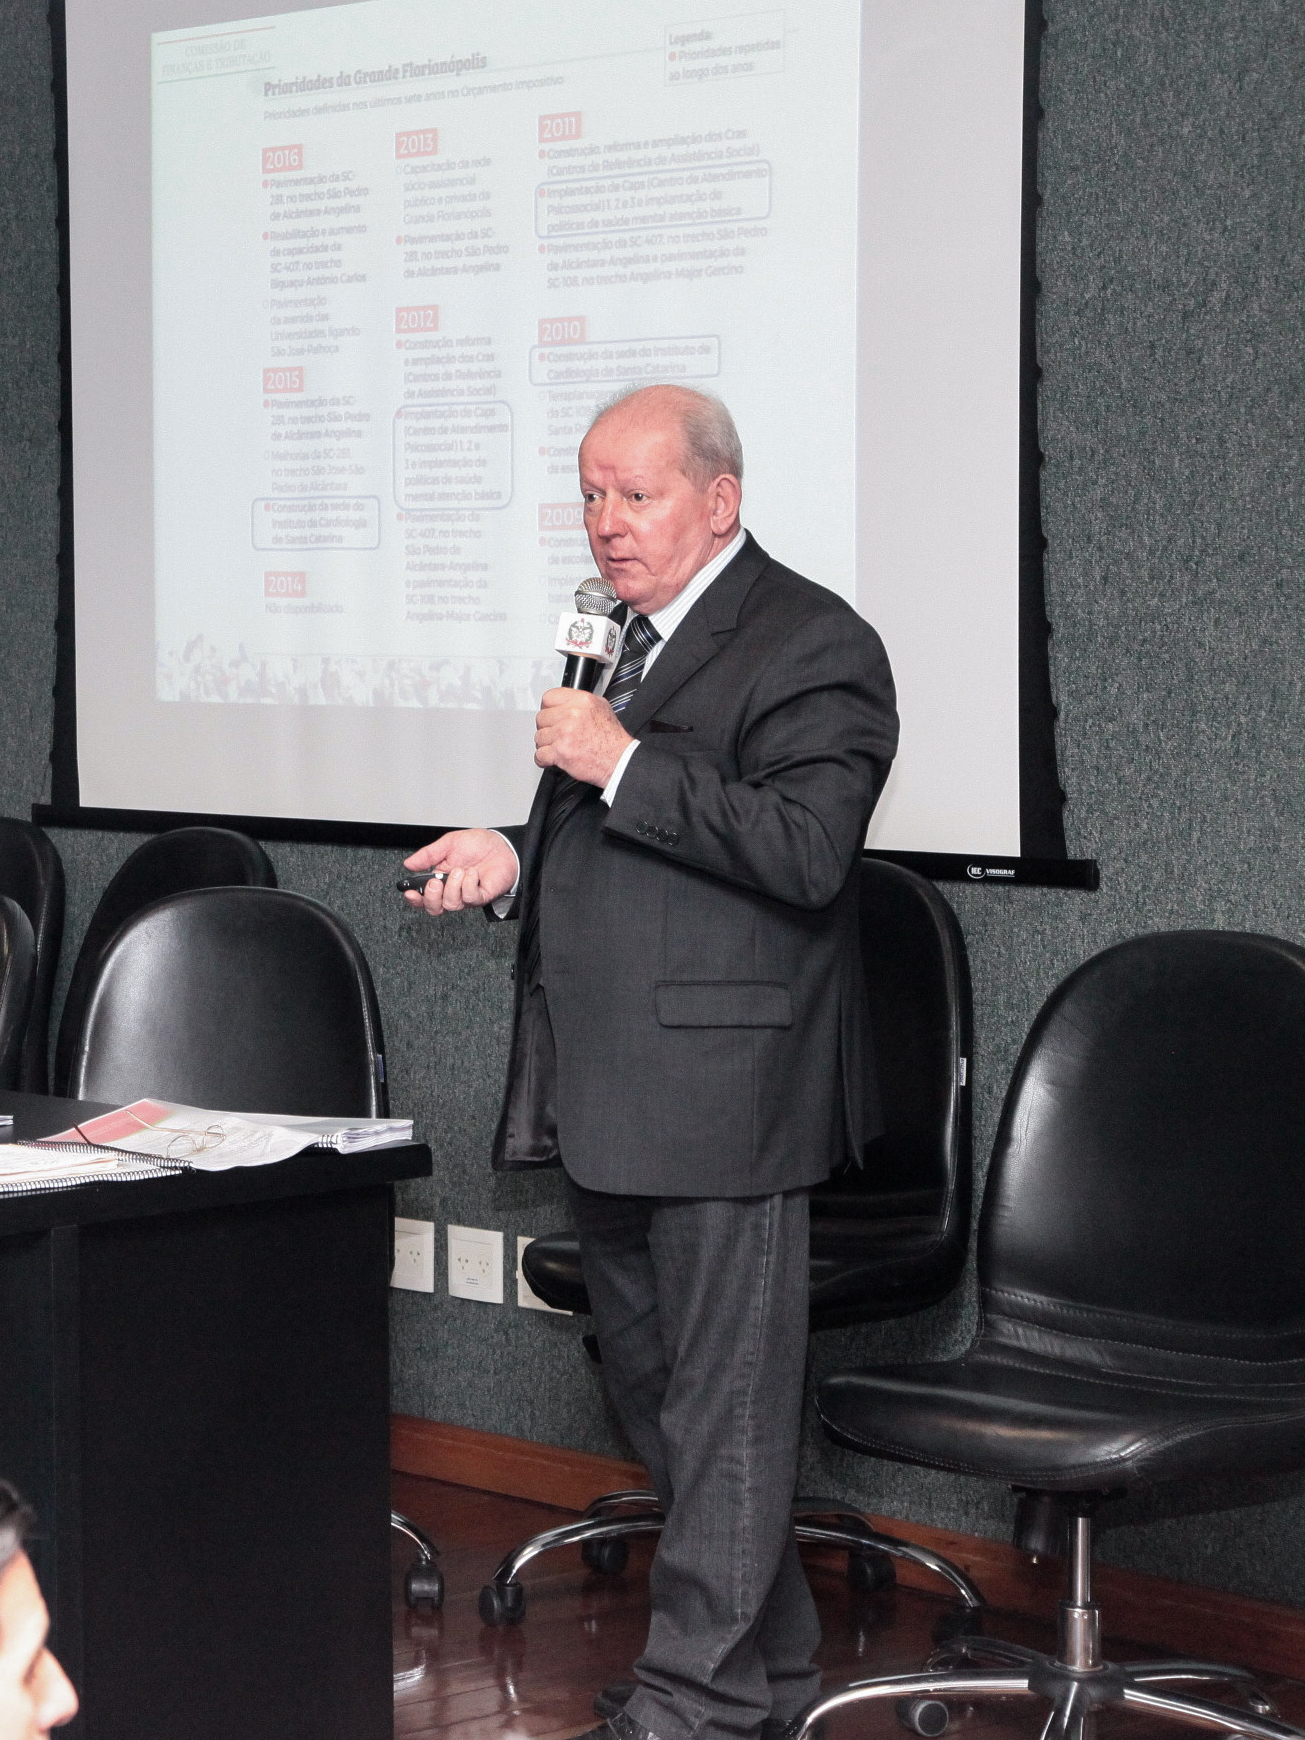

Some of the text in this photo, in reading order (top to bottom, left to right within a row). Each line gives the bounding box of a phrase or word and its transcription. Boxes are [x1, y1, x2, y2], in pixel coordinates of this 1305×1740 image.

[263, 51, 487, 96] Prioridades da Grande Florianópolis
[543, 116, 576, 138] 2011
[400, 133, 433, 154] 2013
[265, 148, 298, 169] 2016
[400, 310, 433, 329] 2012
[544, 321, 580, 341] 2010
[266, 371, 299, 389] 2015
[268, 577, 301, 593] 2014
